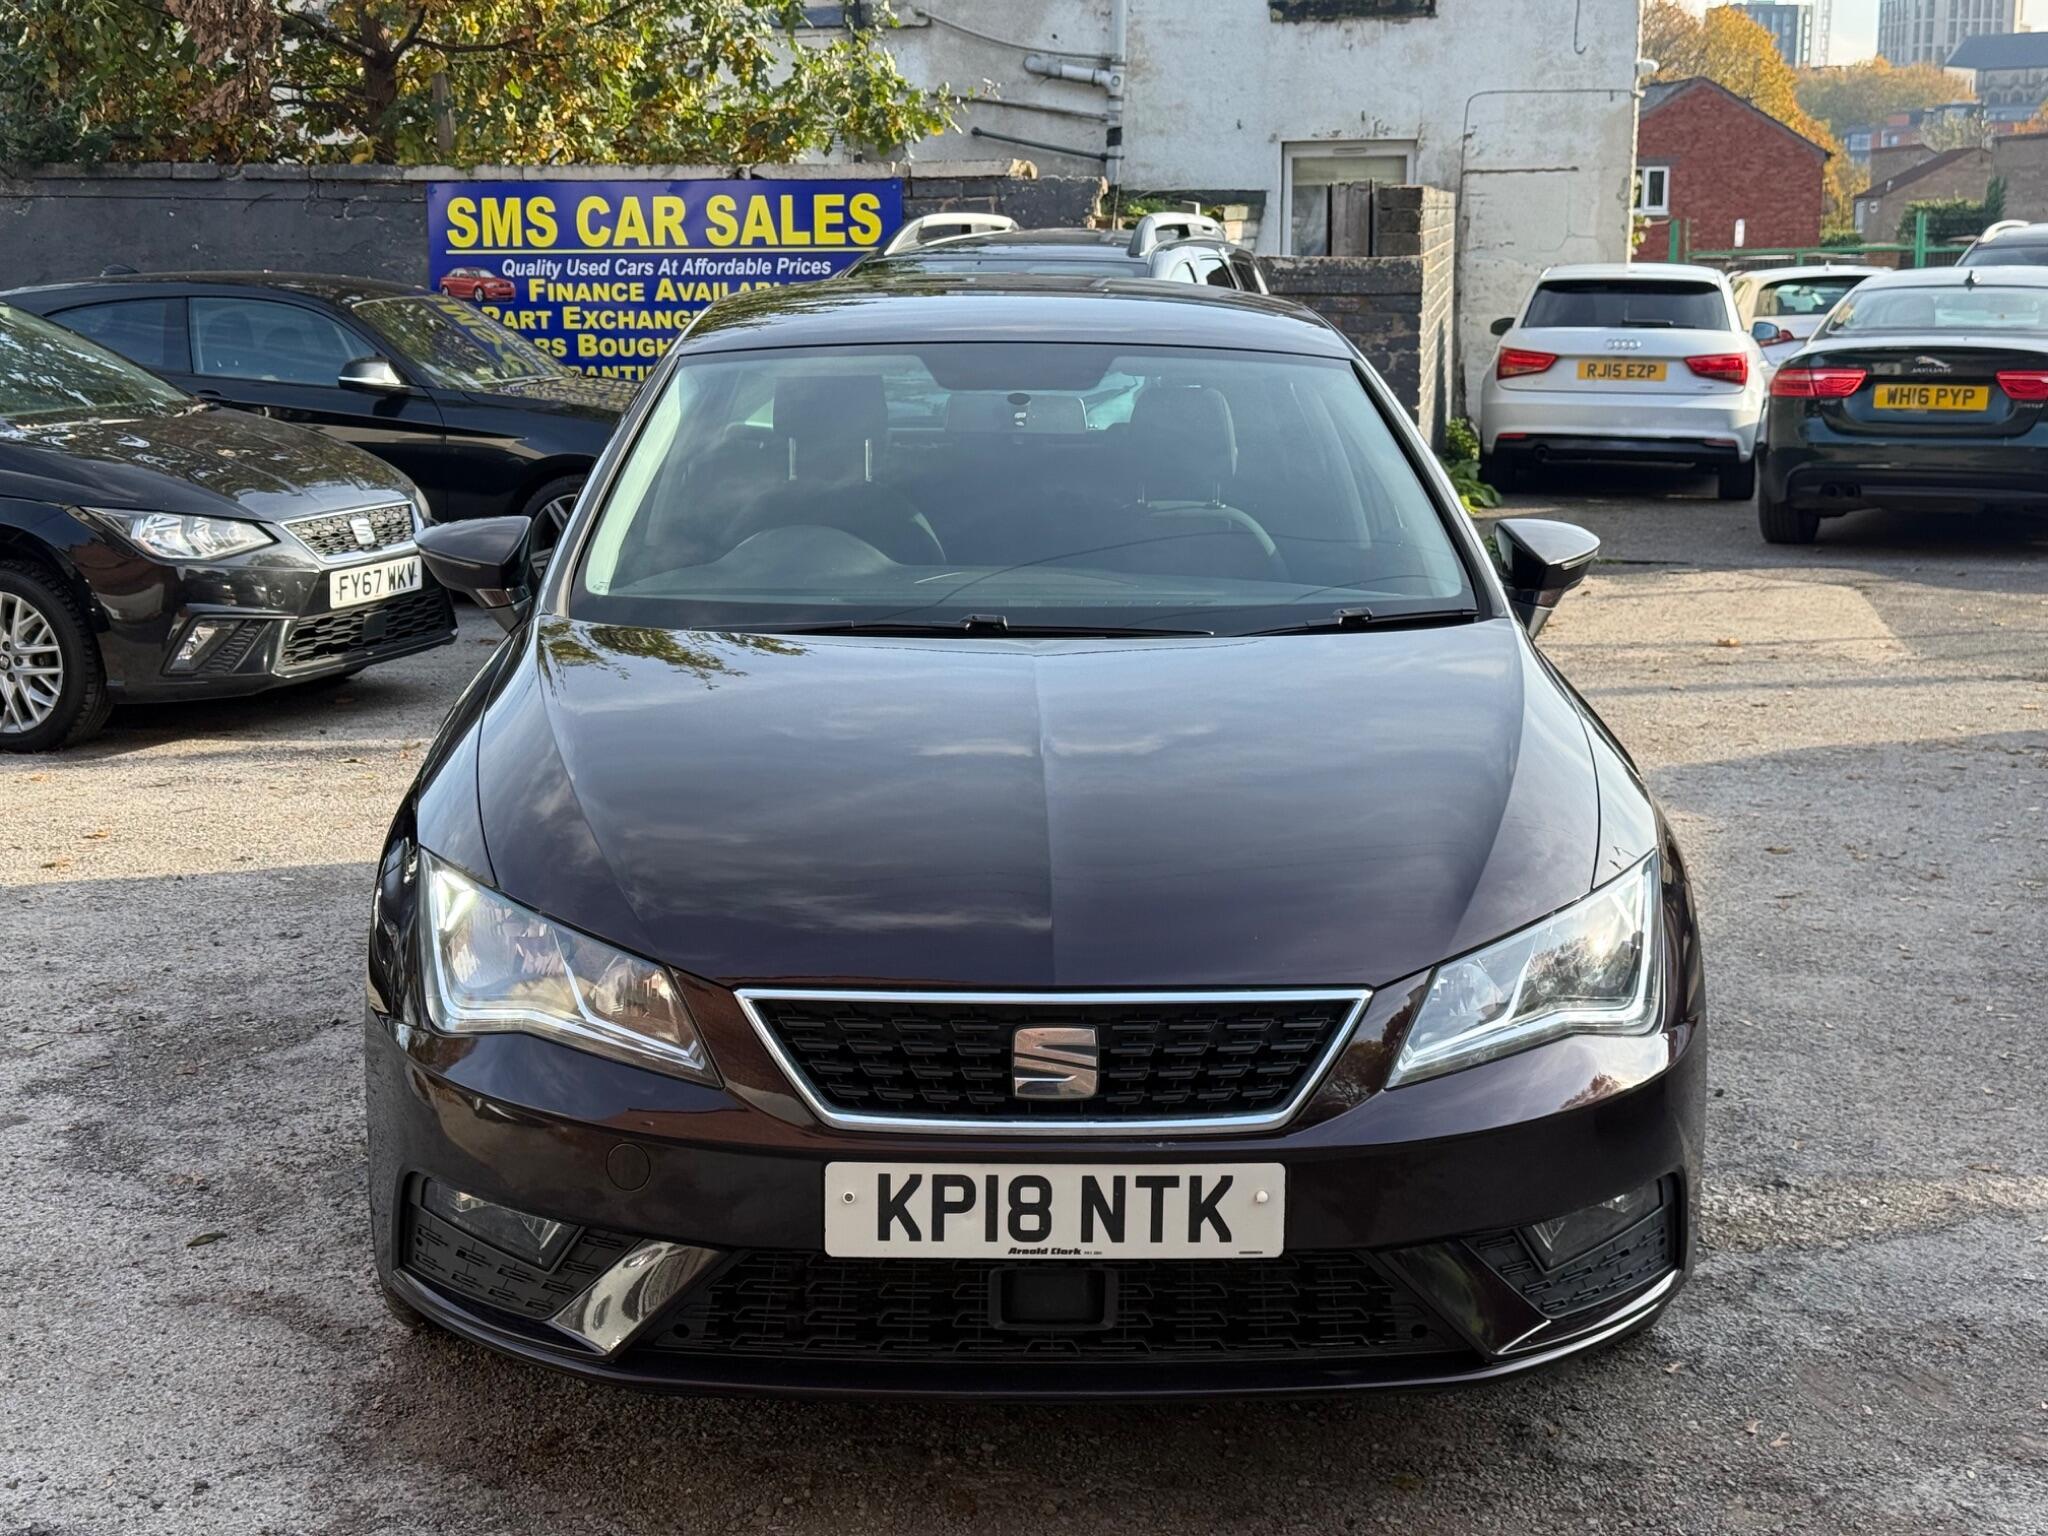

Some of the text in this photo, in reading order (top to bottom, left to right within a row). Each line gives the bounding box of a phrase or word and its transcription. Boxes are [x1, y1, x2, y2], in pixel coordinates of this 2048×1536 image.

[446, 193, 883, 248] SMS CAR SALES
[502, 257, 832, 280] Quality Used Cars At Affordable Prices
[528, 278, 645, 302] FINANCE
[481, 306, 702, 330] PART EXCHANG
[577, 333, 673, 357] BOUGH
[1586, 363, 1657, 378] RJ15 EZP
[1886, 387, 1976, 406] WH16 PYP
[339, 561, 415, 601] FY67 WKV
[877, 1173, 1234, 1244] KP18 NTK
[1007, 1247, 1048, 1256] Arnold
[1050, 1247, 1082, 1256] Clark
